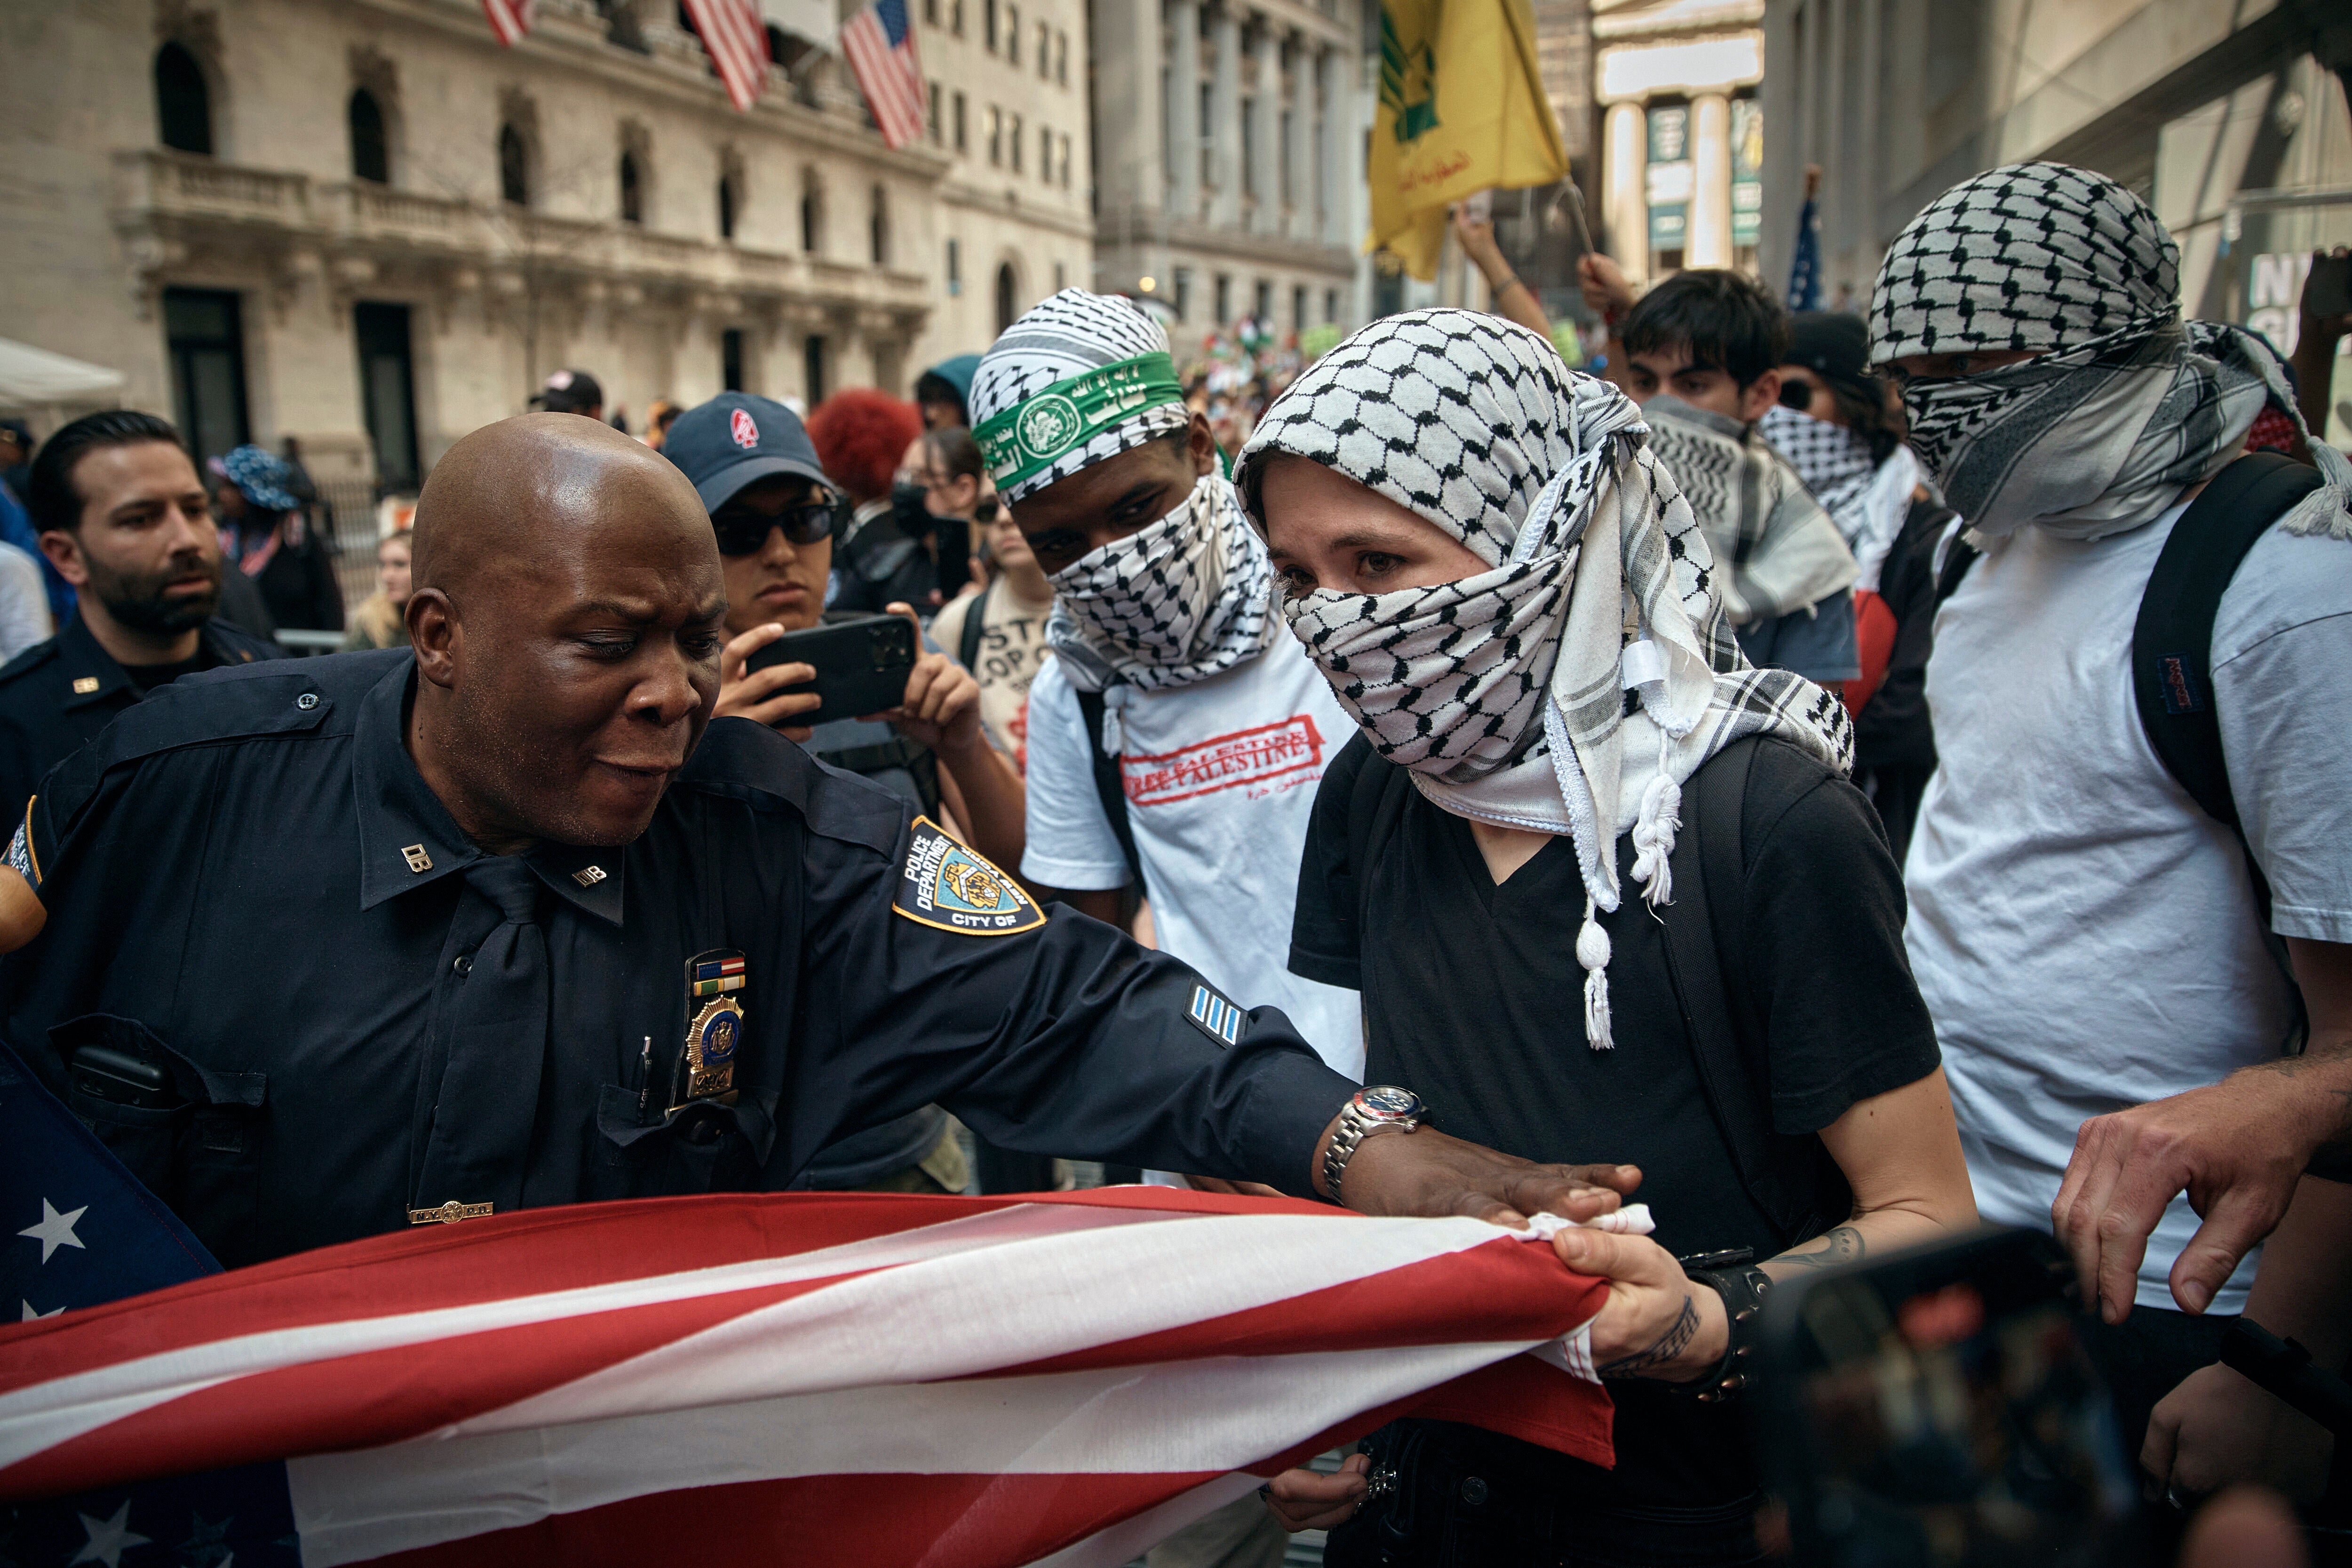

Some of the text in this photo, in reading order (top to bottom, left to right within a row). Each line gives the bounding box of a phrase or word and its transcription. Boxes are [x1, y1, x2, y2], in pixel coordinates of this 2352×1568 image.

[905, 835, 932, 883] POLICE
[917, 835, 953, 912] DEPARTMENT
[952, 846, 1029, 927] CITY OF NEW YORK
